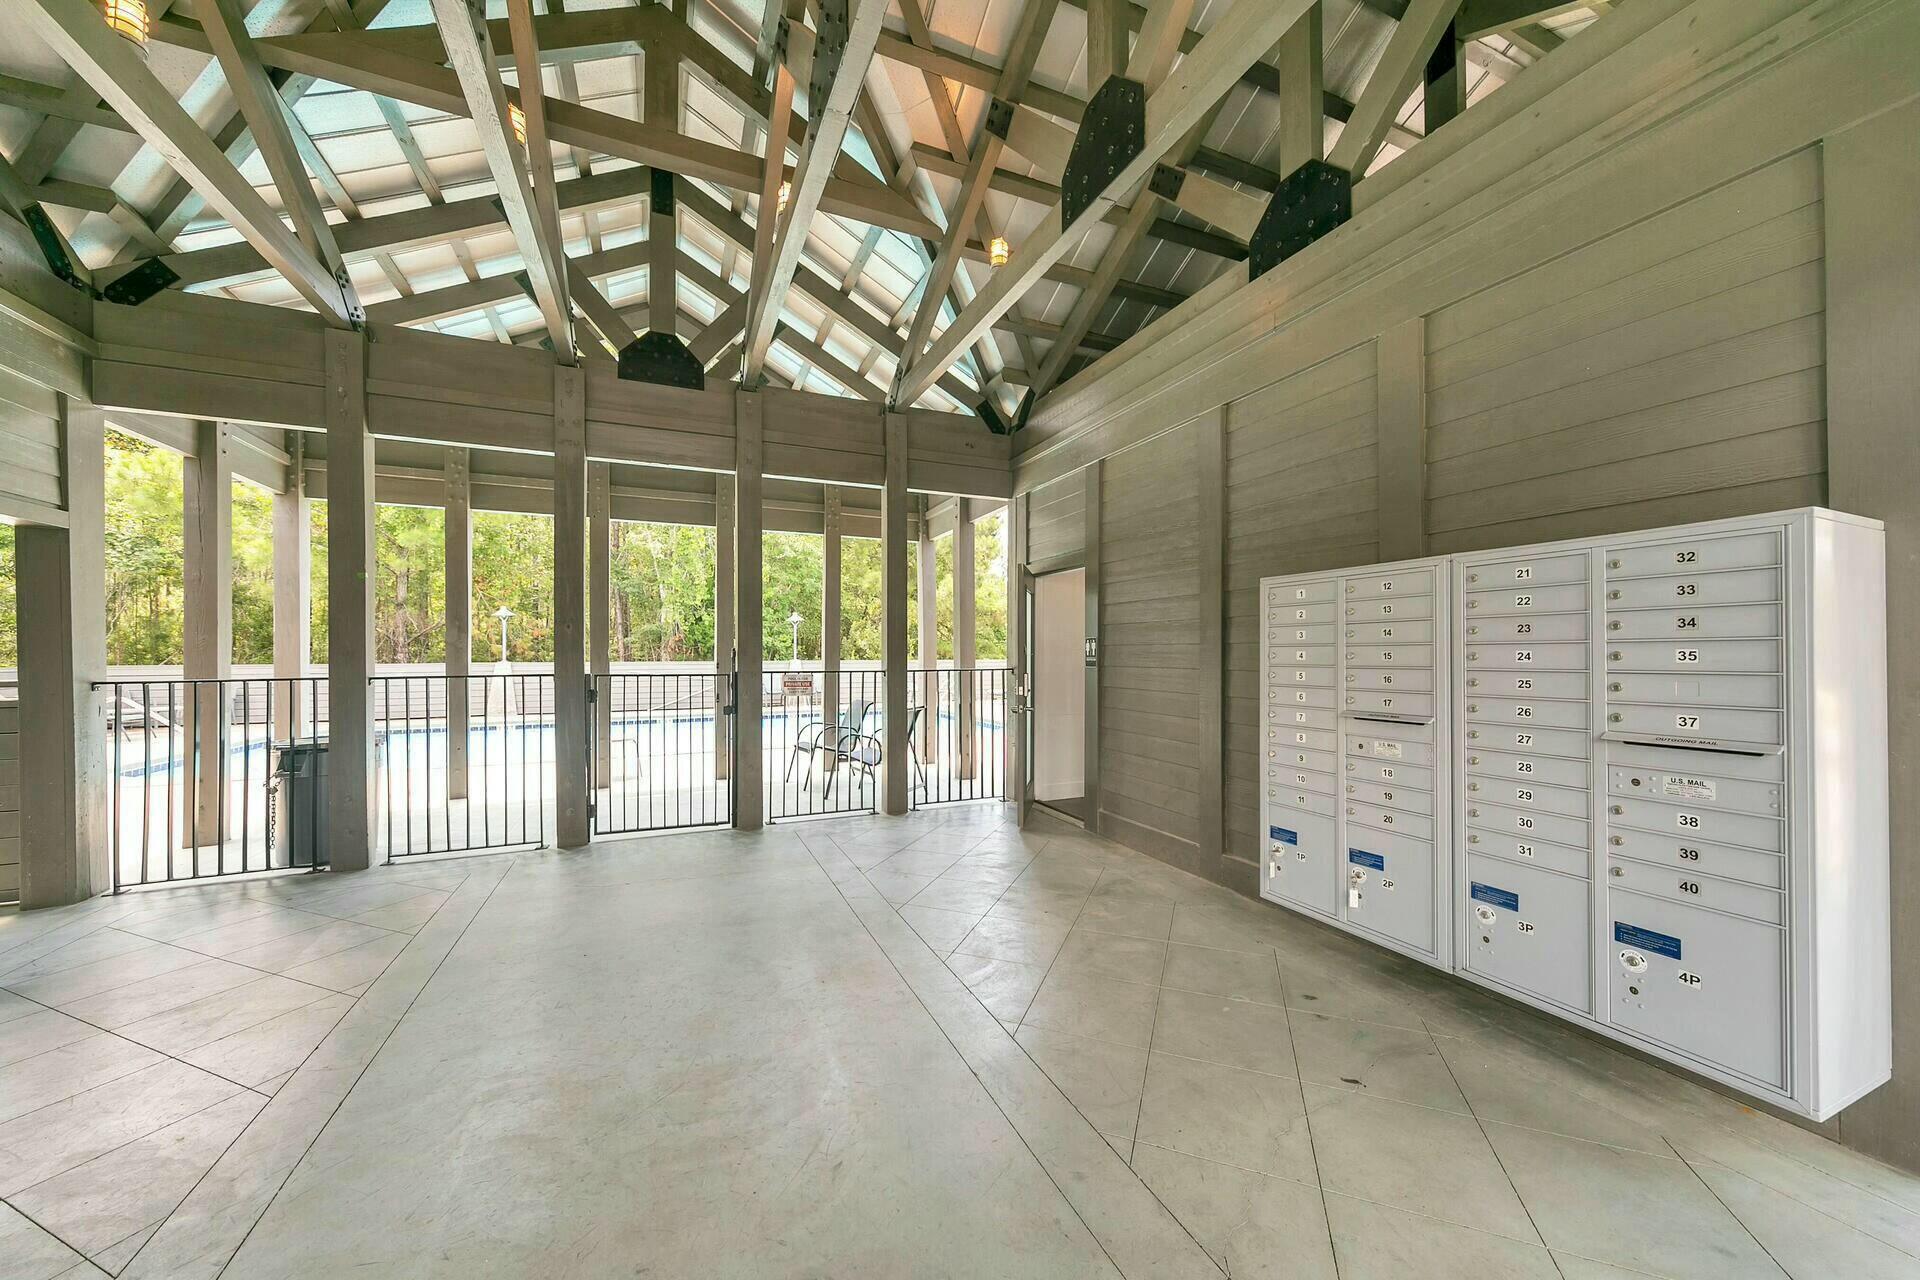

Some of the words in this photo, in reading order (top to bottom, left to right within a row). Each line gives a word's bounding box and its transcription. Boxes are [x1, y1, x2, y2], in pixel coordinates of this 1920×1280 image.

[1676, 551, 1696, 563] 32
[1516, 568, 1530, 579] 21
[1383, 582, 1391, 590] 12
[1676, 584, 1696, 596] 33
[1516, 596, 1531, 606] 22
[1383, 605, 1391, 614] 13
[1517, 623, 1531, 633] 23
[1677, 617, 1697, 629] 34
[1383, 629, 1391, 637] 14
[1383, 652, 1392, 660] 15
[1517, 651, 1531, 661] 24
[1677, 650, 1698, 661] 35
[1383, 675, 1391, 684] 16
[1517, 679, 1532, 689] 25
[1383, 699, 1392, 707] 17
[1517, 707, 1532, 717] 26
[1678, 716, 1698, 728] 37
[1517, 734, 1532, 745] 27
[1655, 736, 1697, 745] OUTGOING
[1518, 762, 1532, 773] 28
[1383, 769, 1392, 778] 18
[1297, 775, 1305, 783] 10
[1670, 777, 1685, 785] U.S.
[1687, 779, 1707, 787] MAIL
[1383, 791, 1392, 801] 19
[1518, 789, 1532, 801] 29
[1383, 814, 1392, 824] 20
[1518, 817, 1533, 829] 30
[1679, 815, 1699, 828] 38
[1519, 845, 1532, 856] 31
[1679, 847, 1699, 861] 39
[1297, 853, 1305, 861] 1P
[1383, 879, 1393, 889] 2P
[1679, 881, 1699, 895] 40
[1518, 921, 1534, 933] 3P
[1678, 972, 1701, 985] 4P
